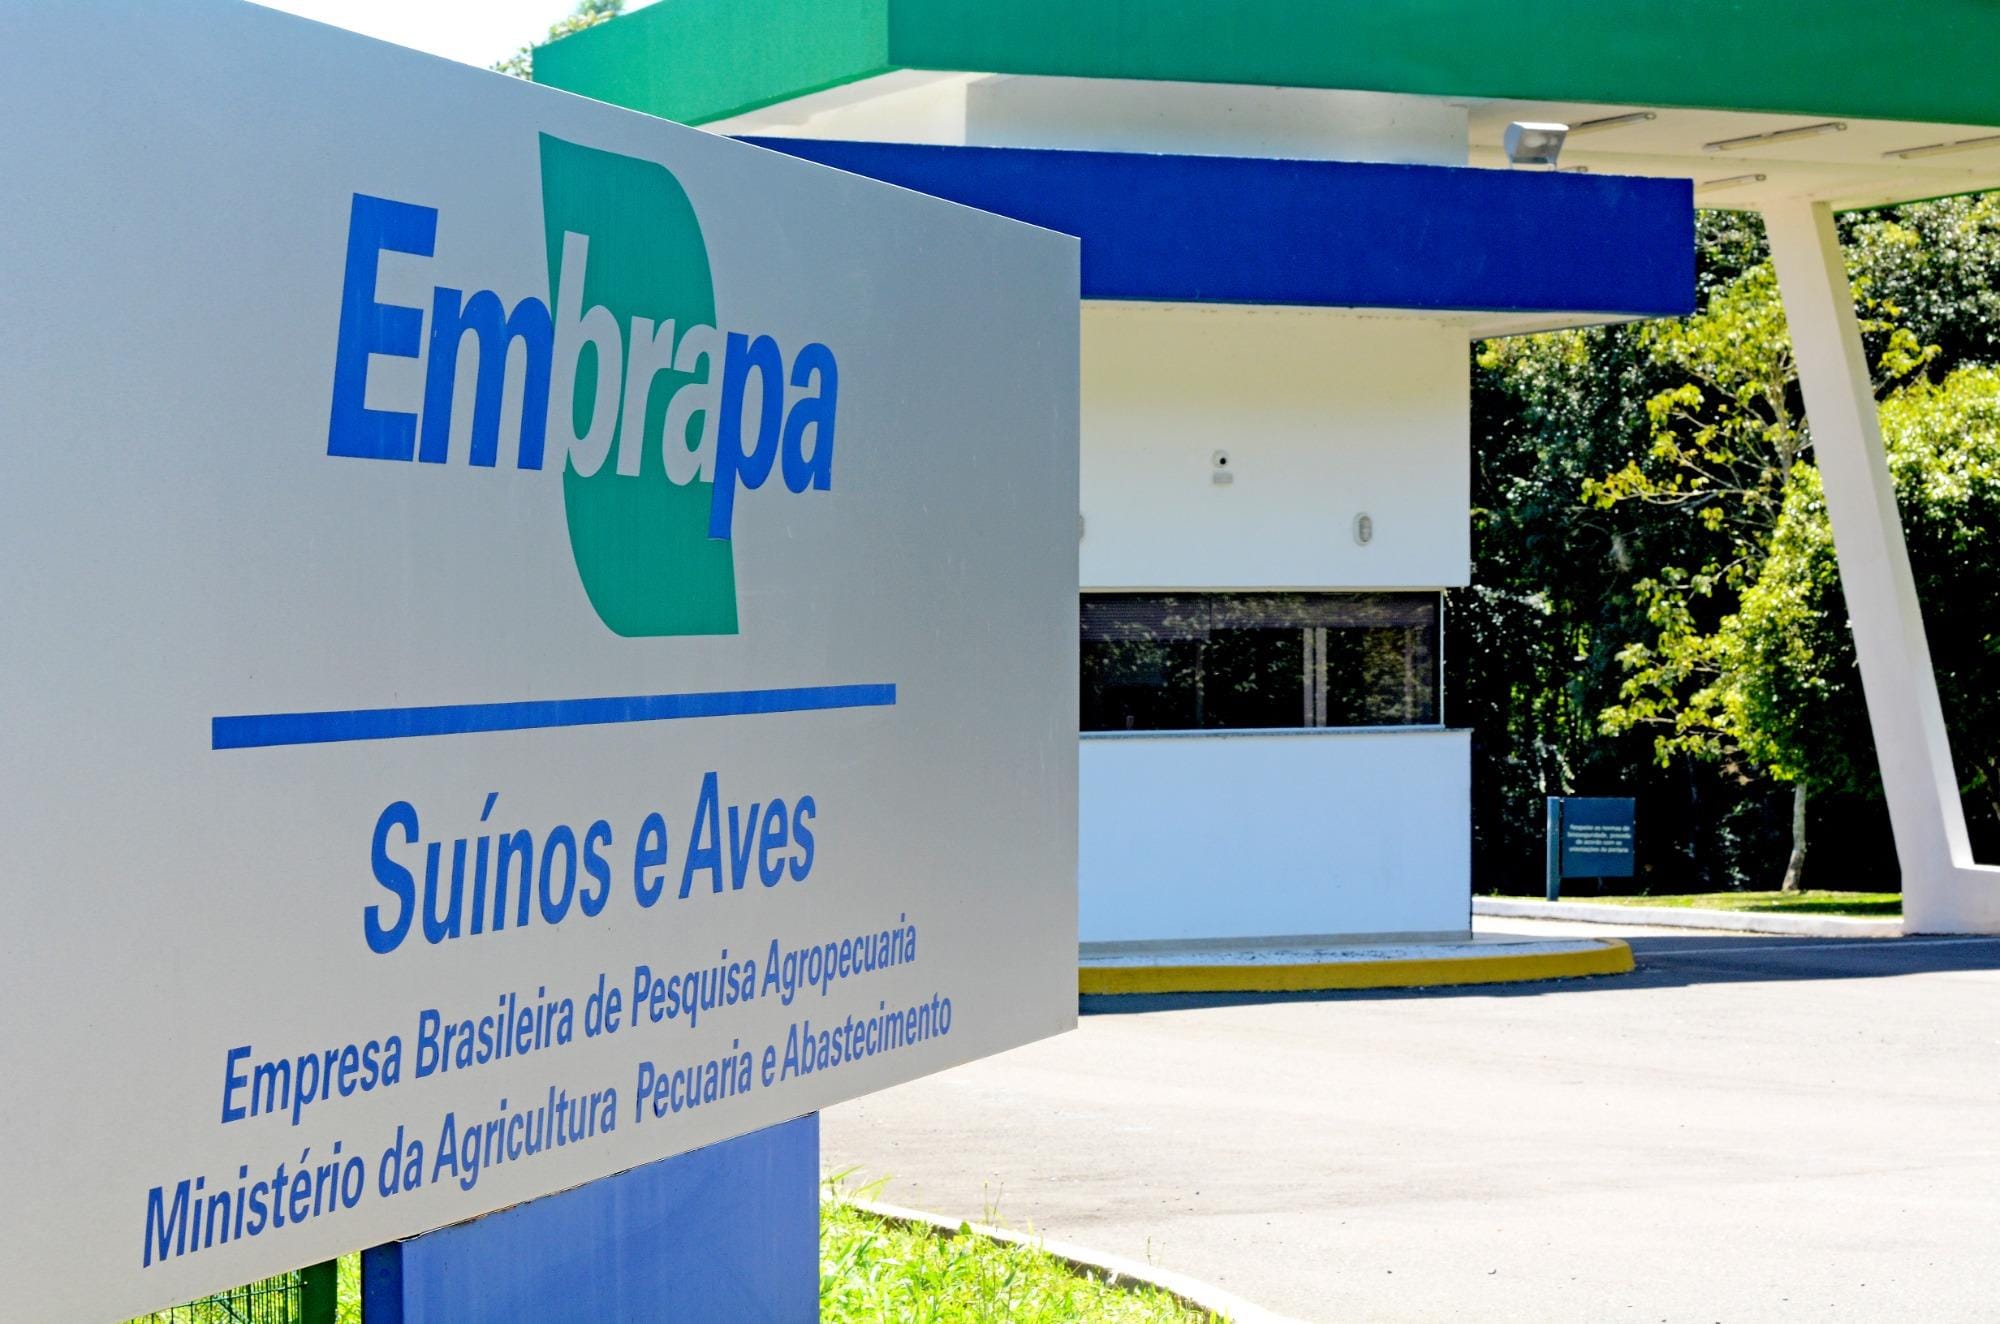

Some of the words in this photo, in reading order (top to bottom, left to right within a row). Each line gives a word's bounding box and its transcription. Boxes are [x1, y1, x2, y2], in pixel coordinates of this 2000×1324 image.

[326, 192, 838, 541] Embrapa
[363, 792, 613, 954] Suínos
[634, 812, 669, 908] e
[679, 771, 817, 899] Aves
[142, 1141, 366, 1268] Ministério
[378, 1125, 424, 1197] da
[432, 1085, 617, 1191] Agricultura
[635, 1038, 753, 1123] Pecuaria
[761, 1044, 777, 1087] e
[780, 992, 952, 1081] Abastecimento
[221, 1035, 402, 1126] Empresa
[414, 986, 575, 1079] Brasileira
[584, 973, 622, 1037] de
[631, 949, 757, 1028] Pesquisa
[760, 912, 917, 1006] Agropecuaria
